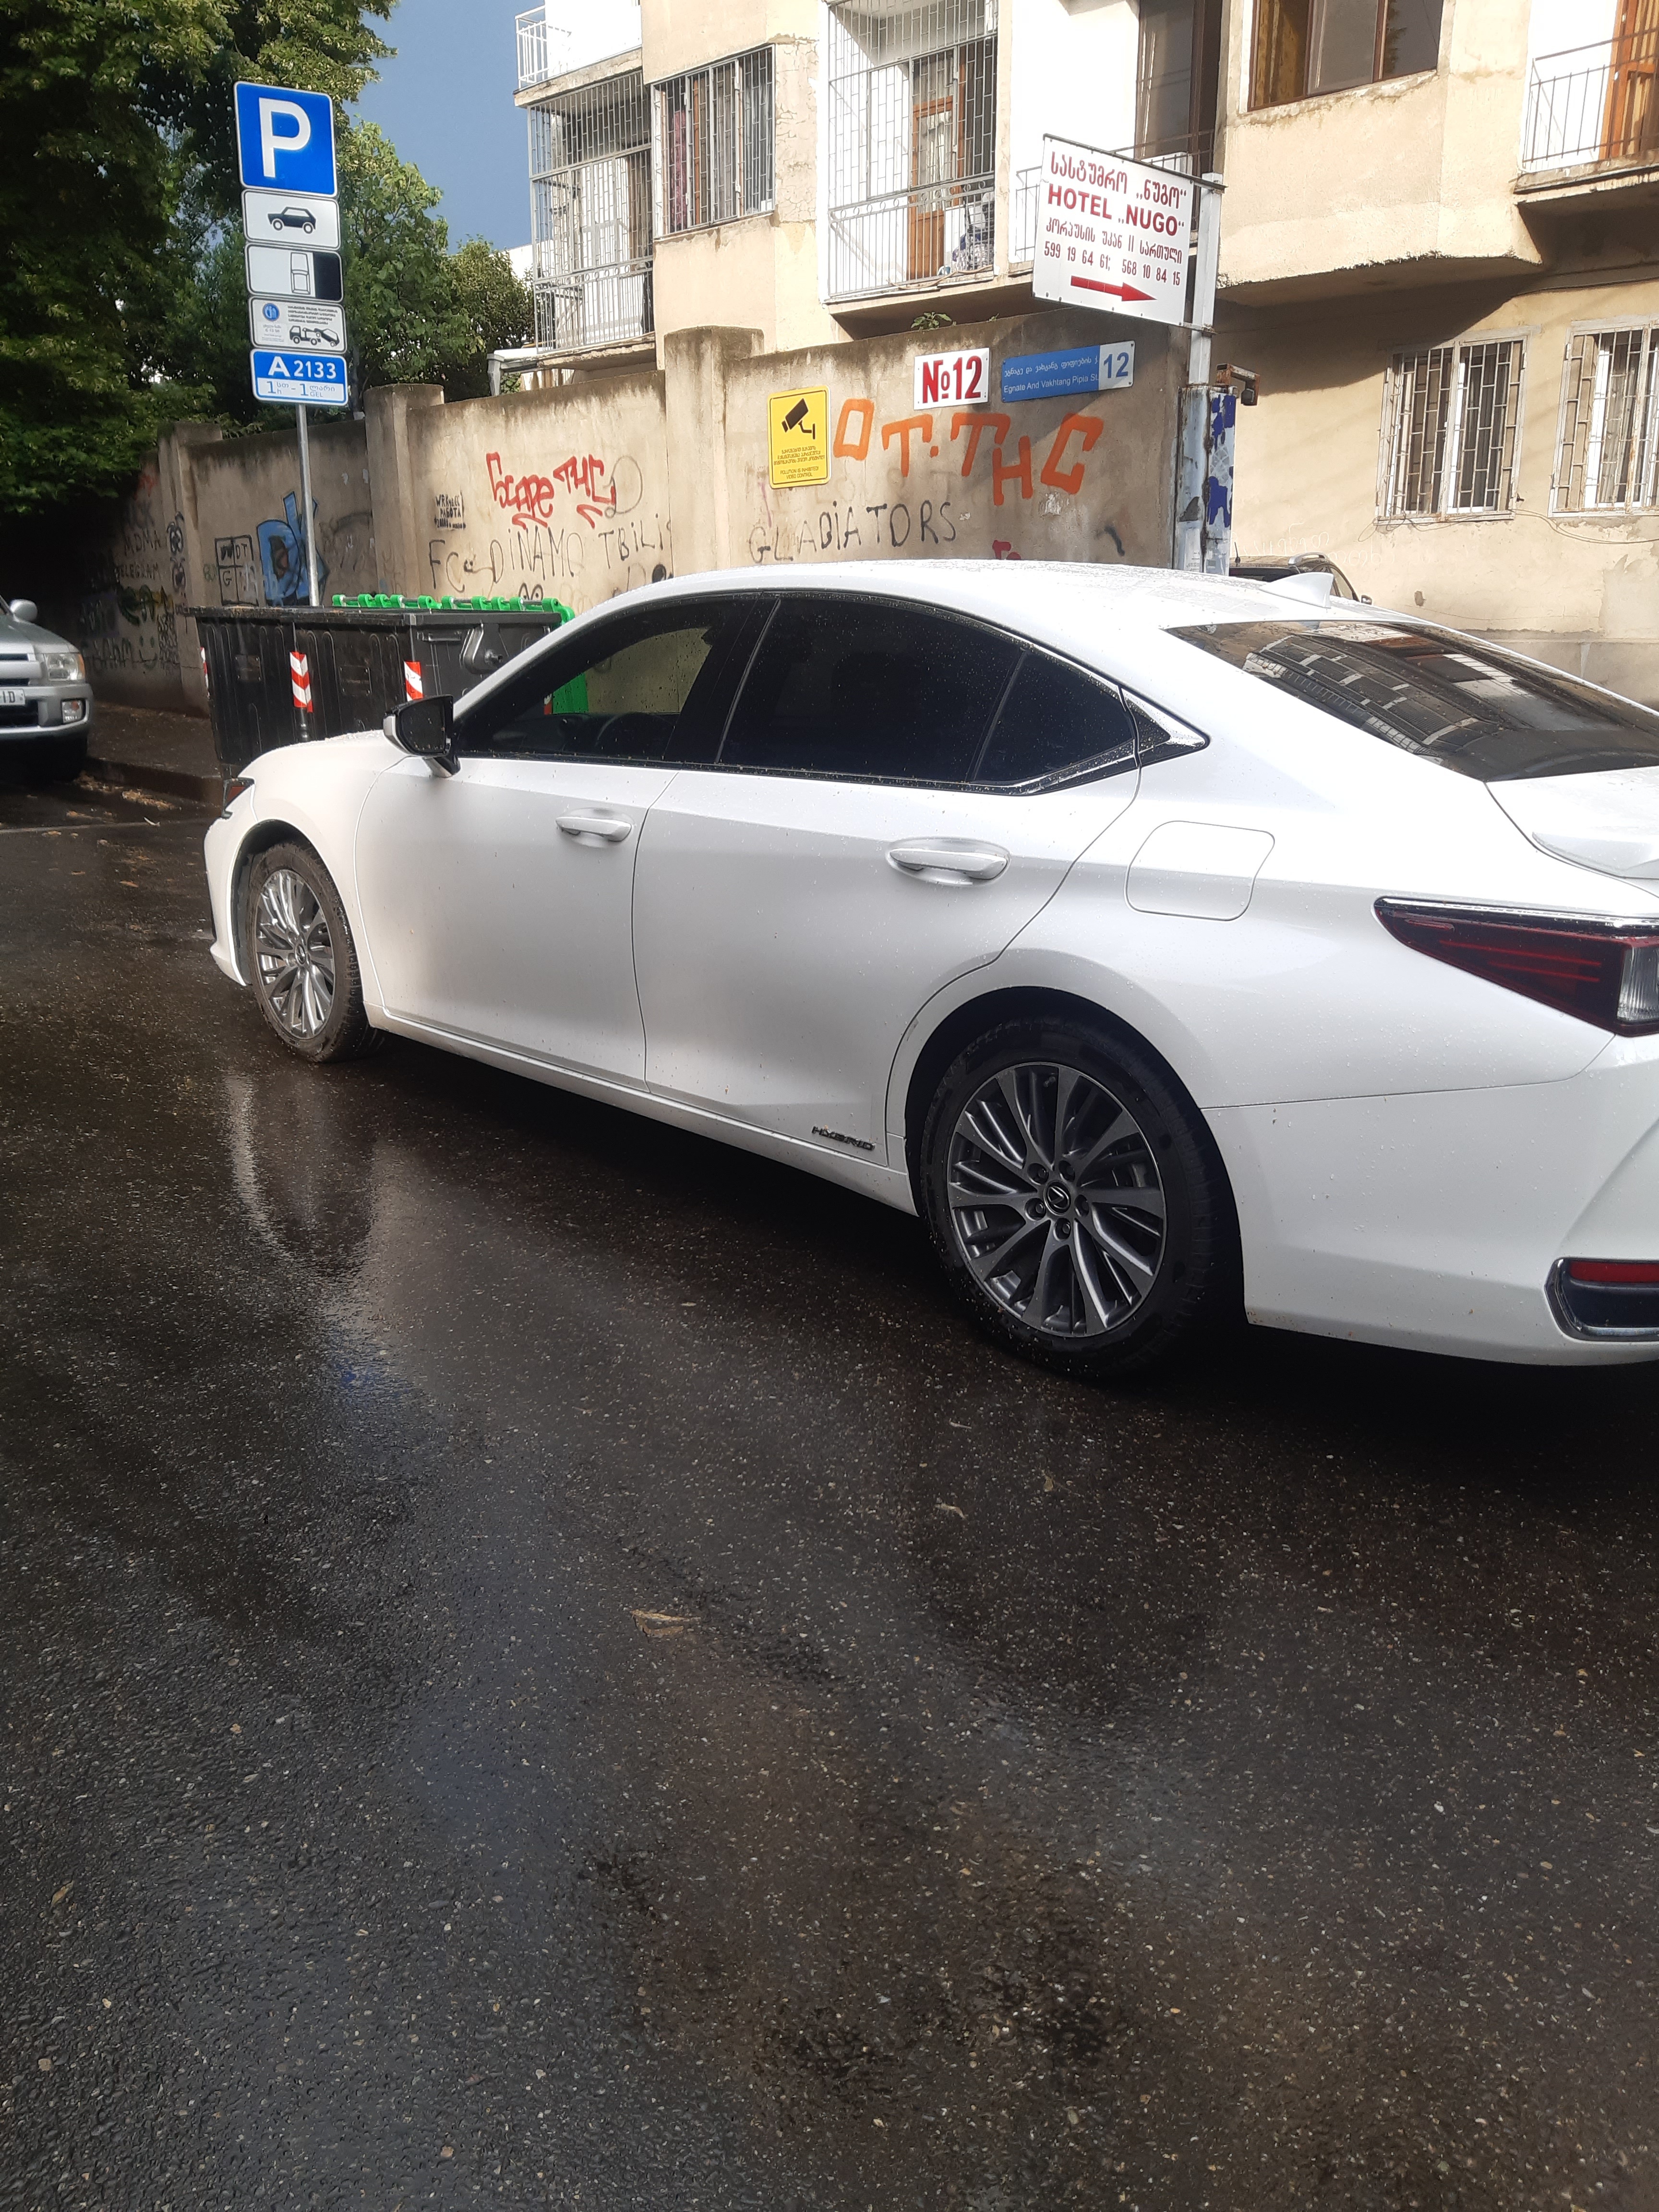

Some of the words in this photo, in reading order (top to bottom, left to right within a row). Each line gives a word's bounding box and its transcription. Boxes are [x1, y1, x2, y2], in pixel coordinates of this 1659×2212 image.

[258, 97, 311, 178] P
[1051, 151, 1127, 194] სასტუმრო
[1048, 183, 1112, 220] HOTEL
[1046, 217, 1095, 242] კორპუსის
[1102, 230, 1122, 249] უკან
[1140, 240, 1182, 264] სართული
[1044, 241, 1061, 259] 599
[1067, 246, 1076, 262] 19
[1082, 250, 1094, 266] 64
[1122, 259, 1137, 276] 568
[1143, 264, 1151, 279] 10
[1156, 267, 1167, 283] 84
[1173, 271, 1181, 286] 15
[267, 355, 291, 377] A
[293, 360, 337, 379] 2133
[1026, 366, 1033, 374] და
[1104, 352, 1129, 379] 12
[266, 381, 276, 394] 1
[299, 383, 309, 397] 1
[1004, 384, 1025, 394] Egnate
[1026, 381, 1039, 390] And
[1041, 377, 1071, 388] Vakhtang
[1072, 375, 1089, 385] Pipia
[811, 1126, 876, 1151] HYBRID
